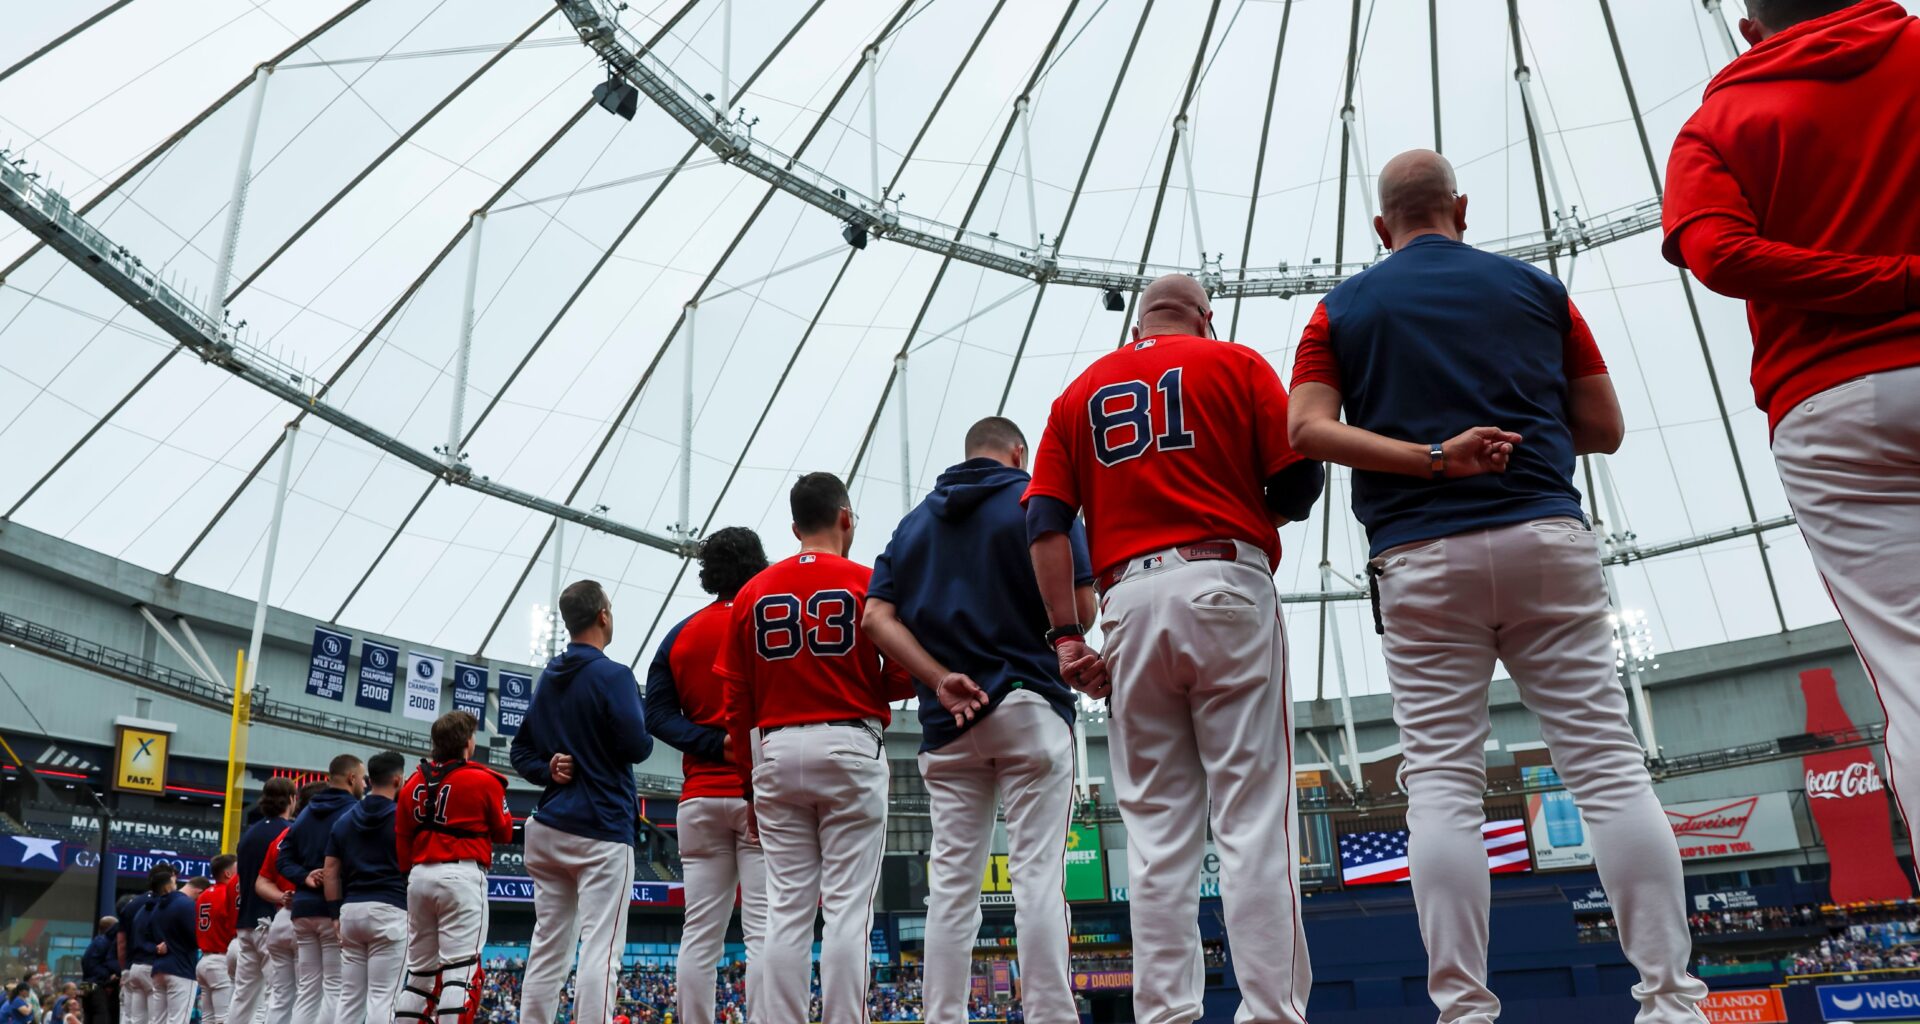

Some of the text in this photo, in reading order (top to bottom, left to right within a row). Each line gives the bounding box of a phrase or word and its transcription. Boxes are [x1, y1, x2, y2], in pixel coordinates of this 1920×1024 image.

[1088, 367, 1195, 467] 81
[753, 589, 856, 662] 83
[361, 670, 393, 684] CHAMPIONS
[361, 684, 389, 701] 2008
[408, 681, 439, 694] CHAMPIONS
[409, 695, 435, 711] 2008
[127, 775, 155, 786] FAST.
[1806, 761, 1884, 799] Coca-Cola
[412, 784, 452, 824] 31
[1672, 814, 1748, 832] udweiser
[1679, 841, 1756, 858] UD'S FOR YOU.
[75, 851, 128, 871] GAE
